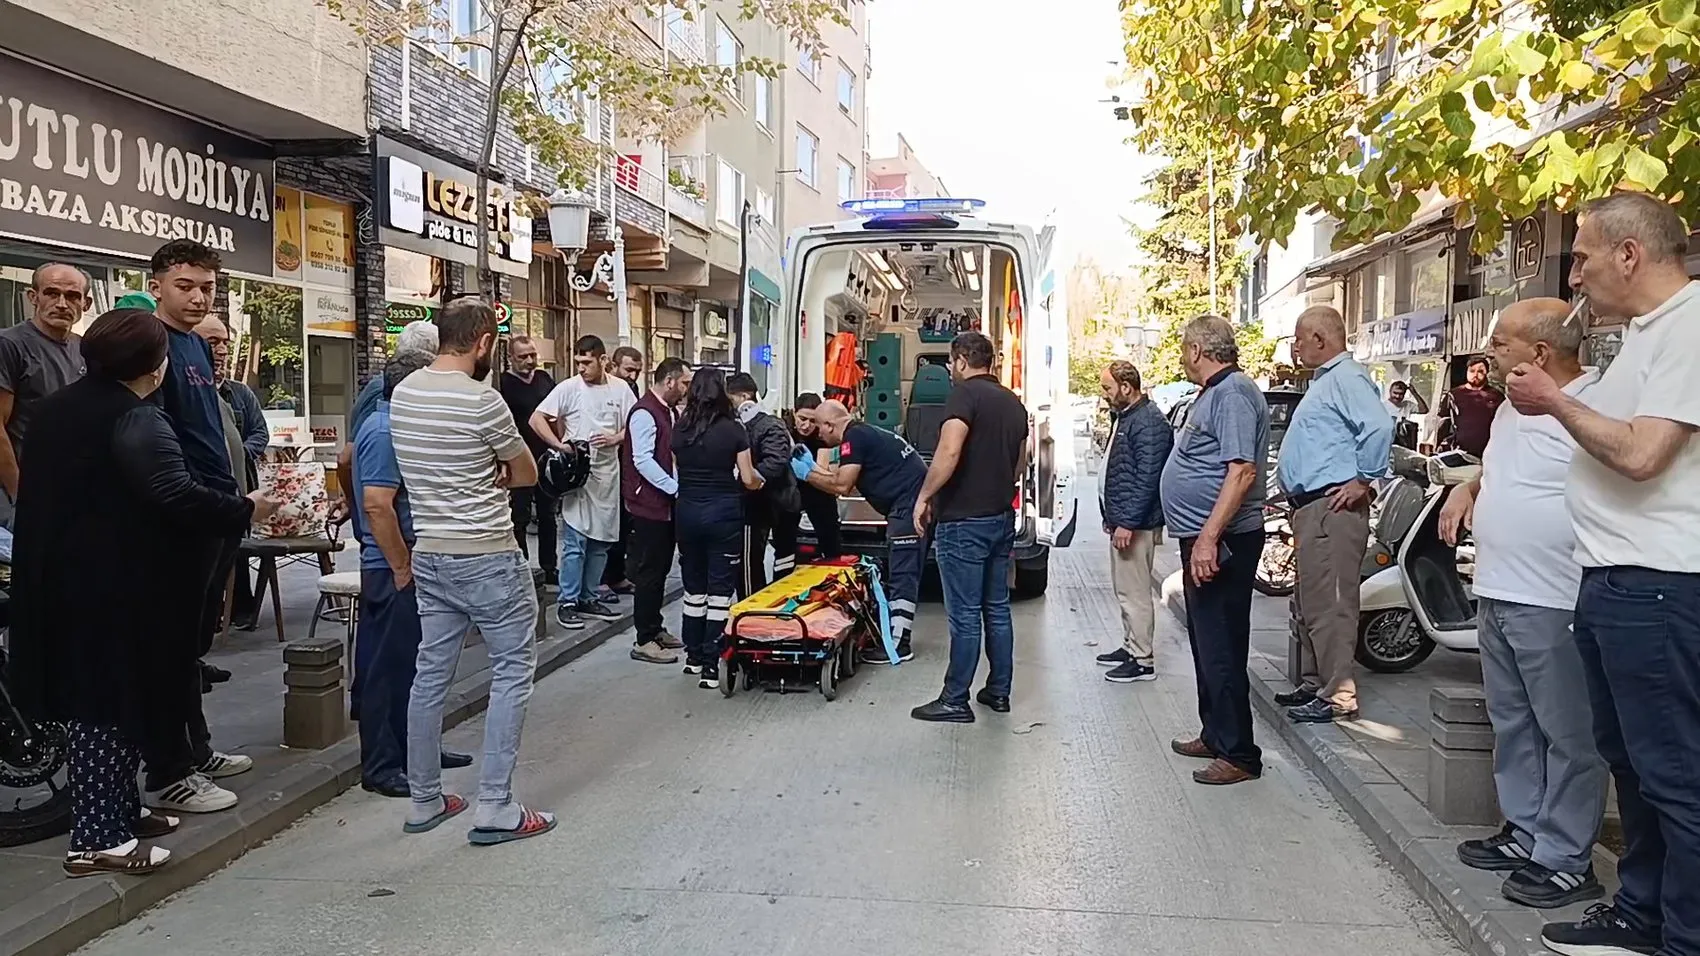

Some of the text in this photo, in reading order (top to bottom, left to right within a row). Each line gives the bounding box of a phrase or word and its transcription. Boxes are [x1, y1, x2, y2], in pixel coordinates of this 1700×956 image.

[0, 178, 236, 252] BAZA AKSESUAR
[137, 137, 270, 222] MOBİLYA
